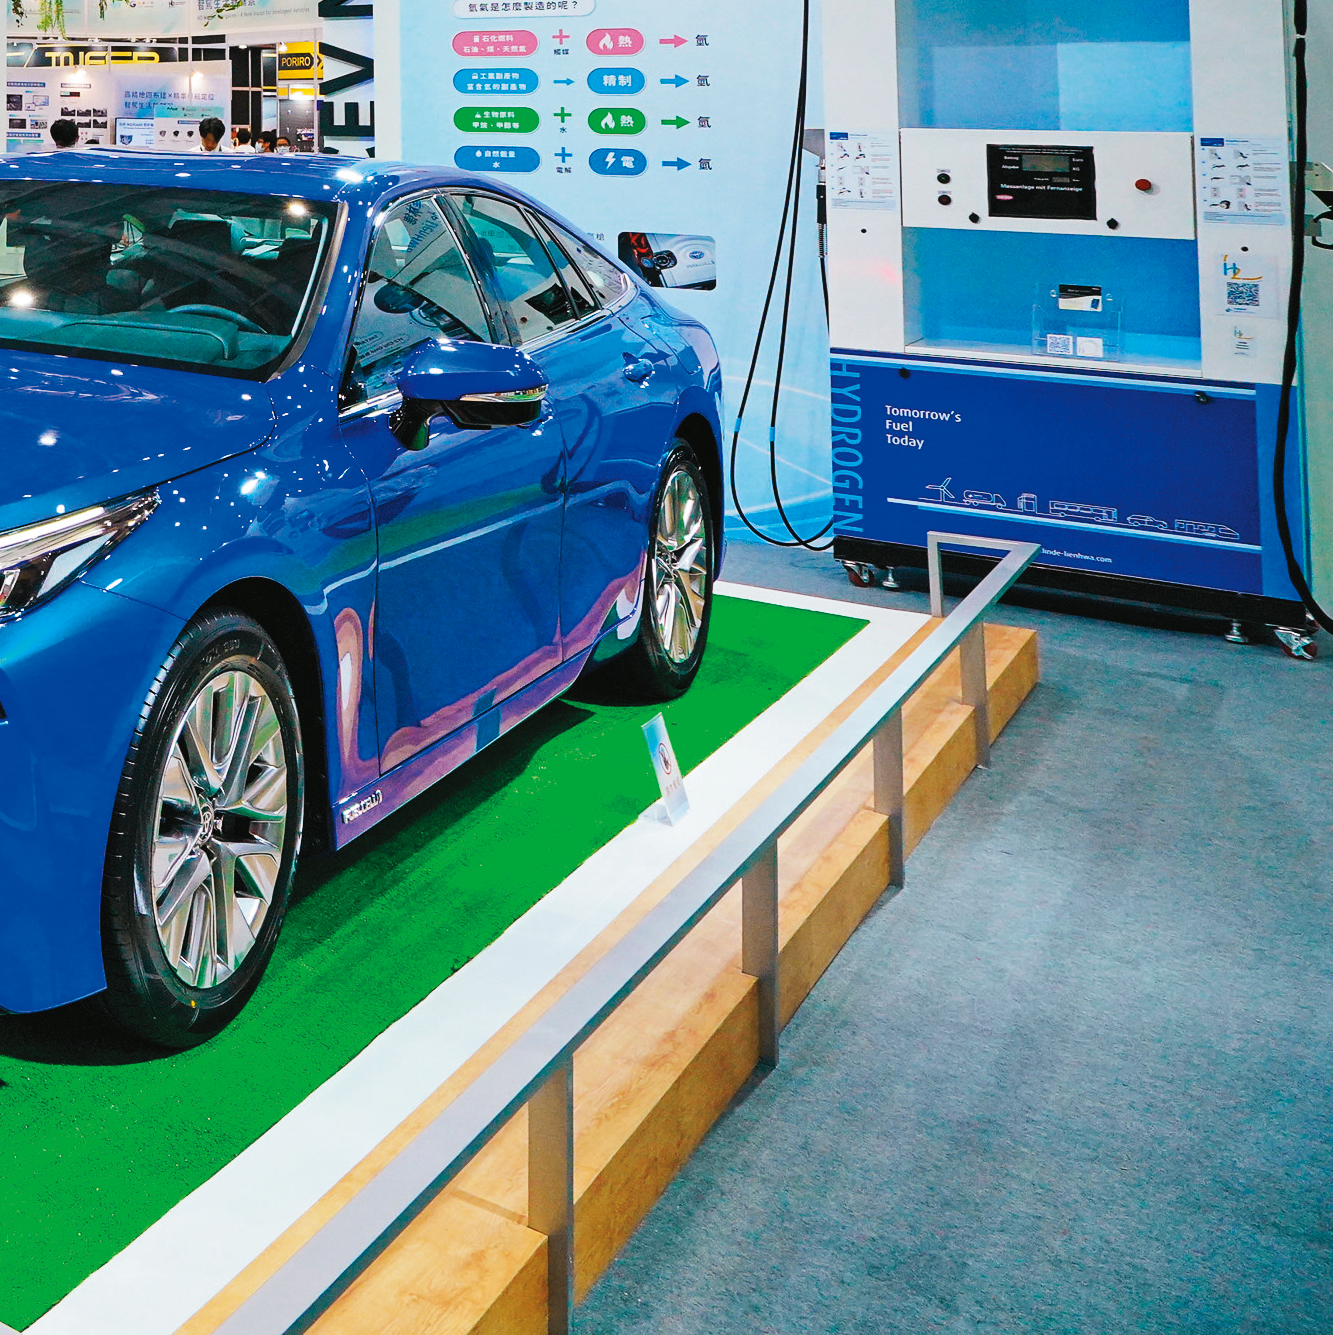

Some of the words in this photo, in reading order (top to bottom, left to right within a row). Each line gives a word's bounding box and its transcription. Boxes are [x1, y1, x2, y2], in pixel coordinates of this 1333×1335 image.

[482, 34, 514, 43] 石化燃料
[618, 35, 633, 48] 熱
[695, 34, 710, 47] 氫
[463, 45, 527, 54] 石油、煤、天然氣
[281, 55, 312, 68] PORIRO
[480, 72, 520, 80] 工業副產物
[696, 74, 711, 87] 氫
[318, 41, 376, 159] EV
[484, 111, 515, 119] 生物原料
[620, 115, 635, 128] 熱
[697, 116, 712, 129] 氫
[559, 126, 567, 134] 水
[492, 161, 501, 169] 水
[620, 156, 635, 168] 電
[698, 157, 713, 171] 氫
[885, 404, 962, 423] Tomorrow's
[885, 419, 913, 432] Fuel
[830, 358, 864, 533] HYDROGEN
[886, 433, 925, 450] Today
